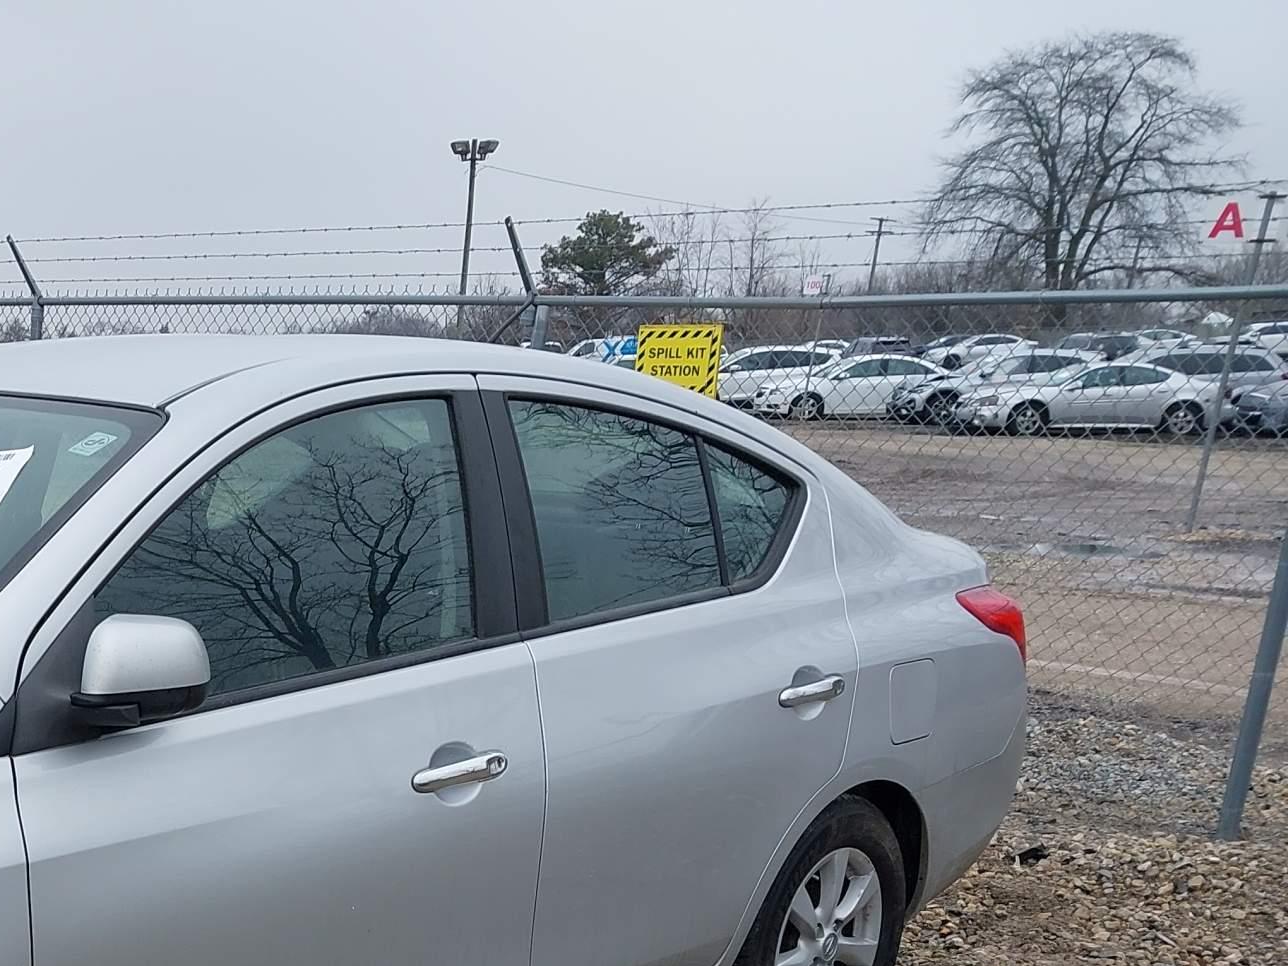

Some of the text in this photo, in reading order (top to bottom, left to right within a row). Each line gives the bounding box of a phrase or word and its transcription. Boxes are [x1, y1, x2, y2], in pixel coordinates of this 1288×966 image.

[1208, 202, 1243, 238] A
[648, 347, 707, 359] SPILL KIT
[650, 365, 701, 377] STATION
